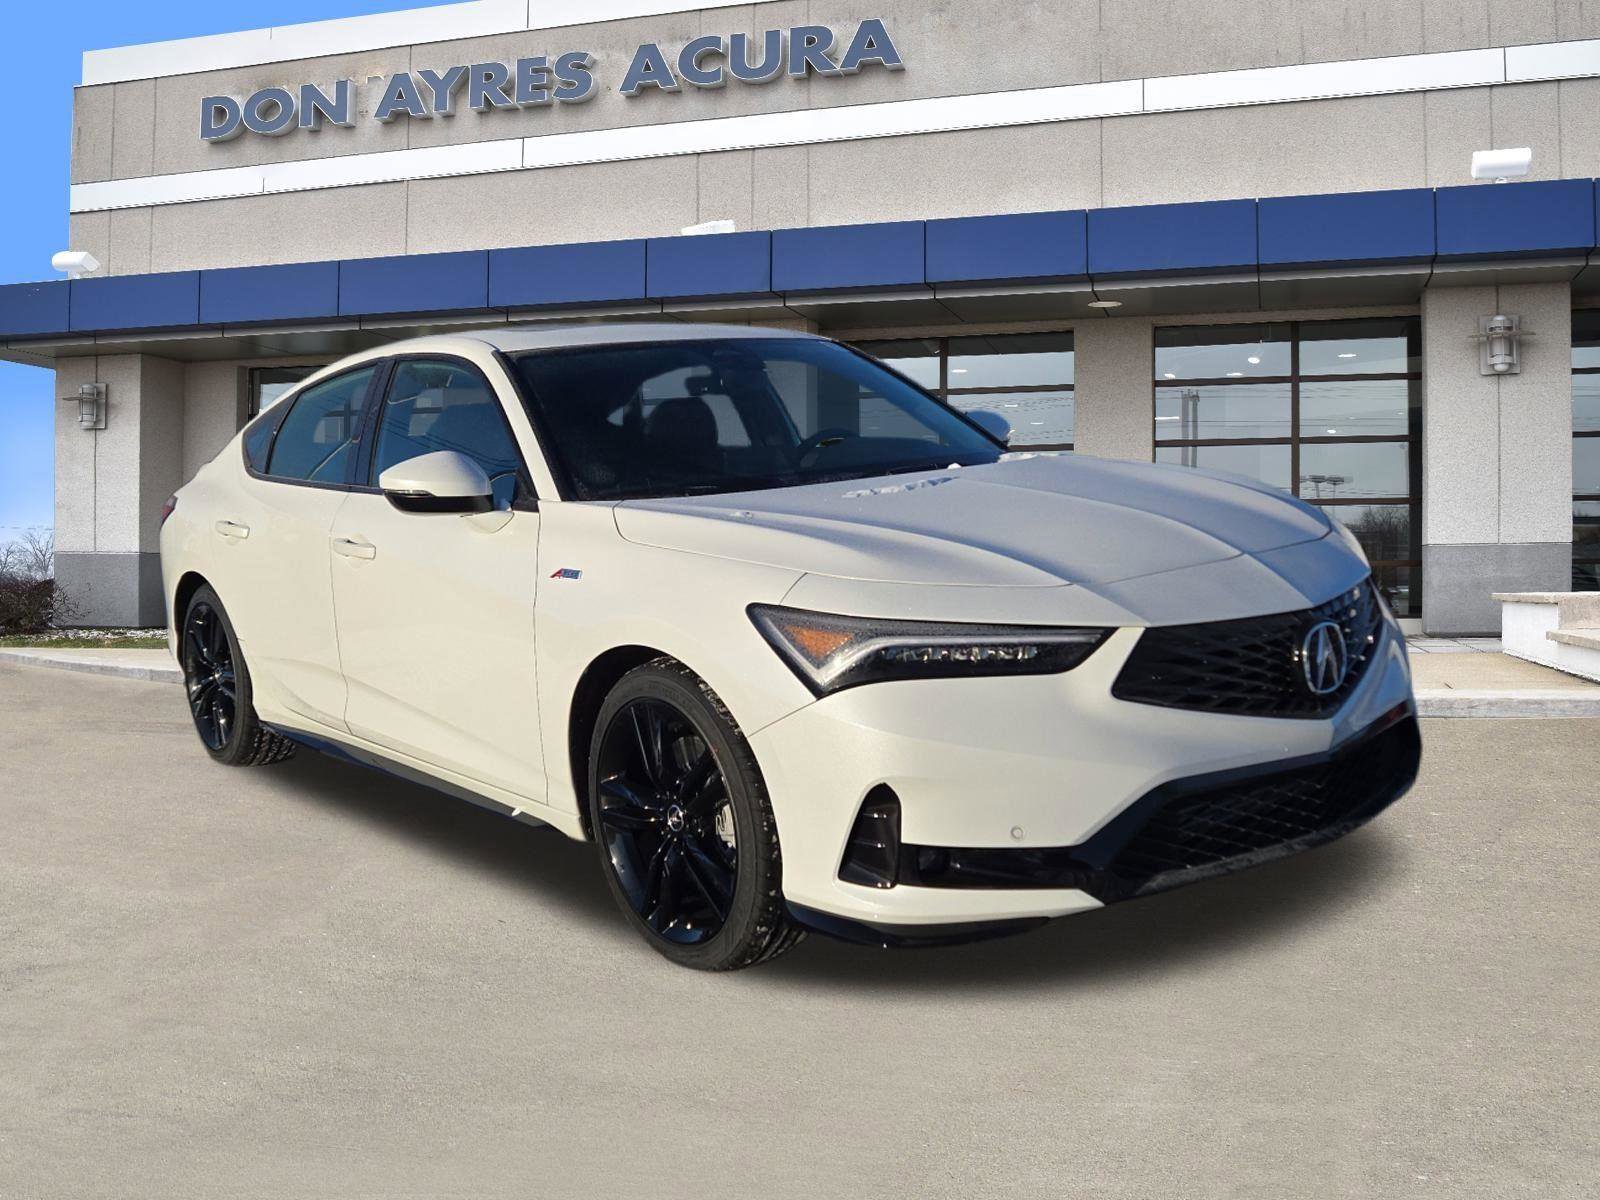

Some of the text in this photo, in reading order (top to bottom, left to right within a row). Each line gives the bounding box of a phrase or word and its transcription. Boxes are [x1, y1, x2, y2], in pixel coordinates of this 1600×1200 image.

[200, 18, 904, 142] DON AYRES ACURA
